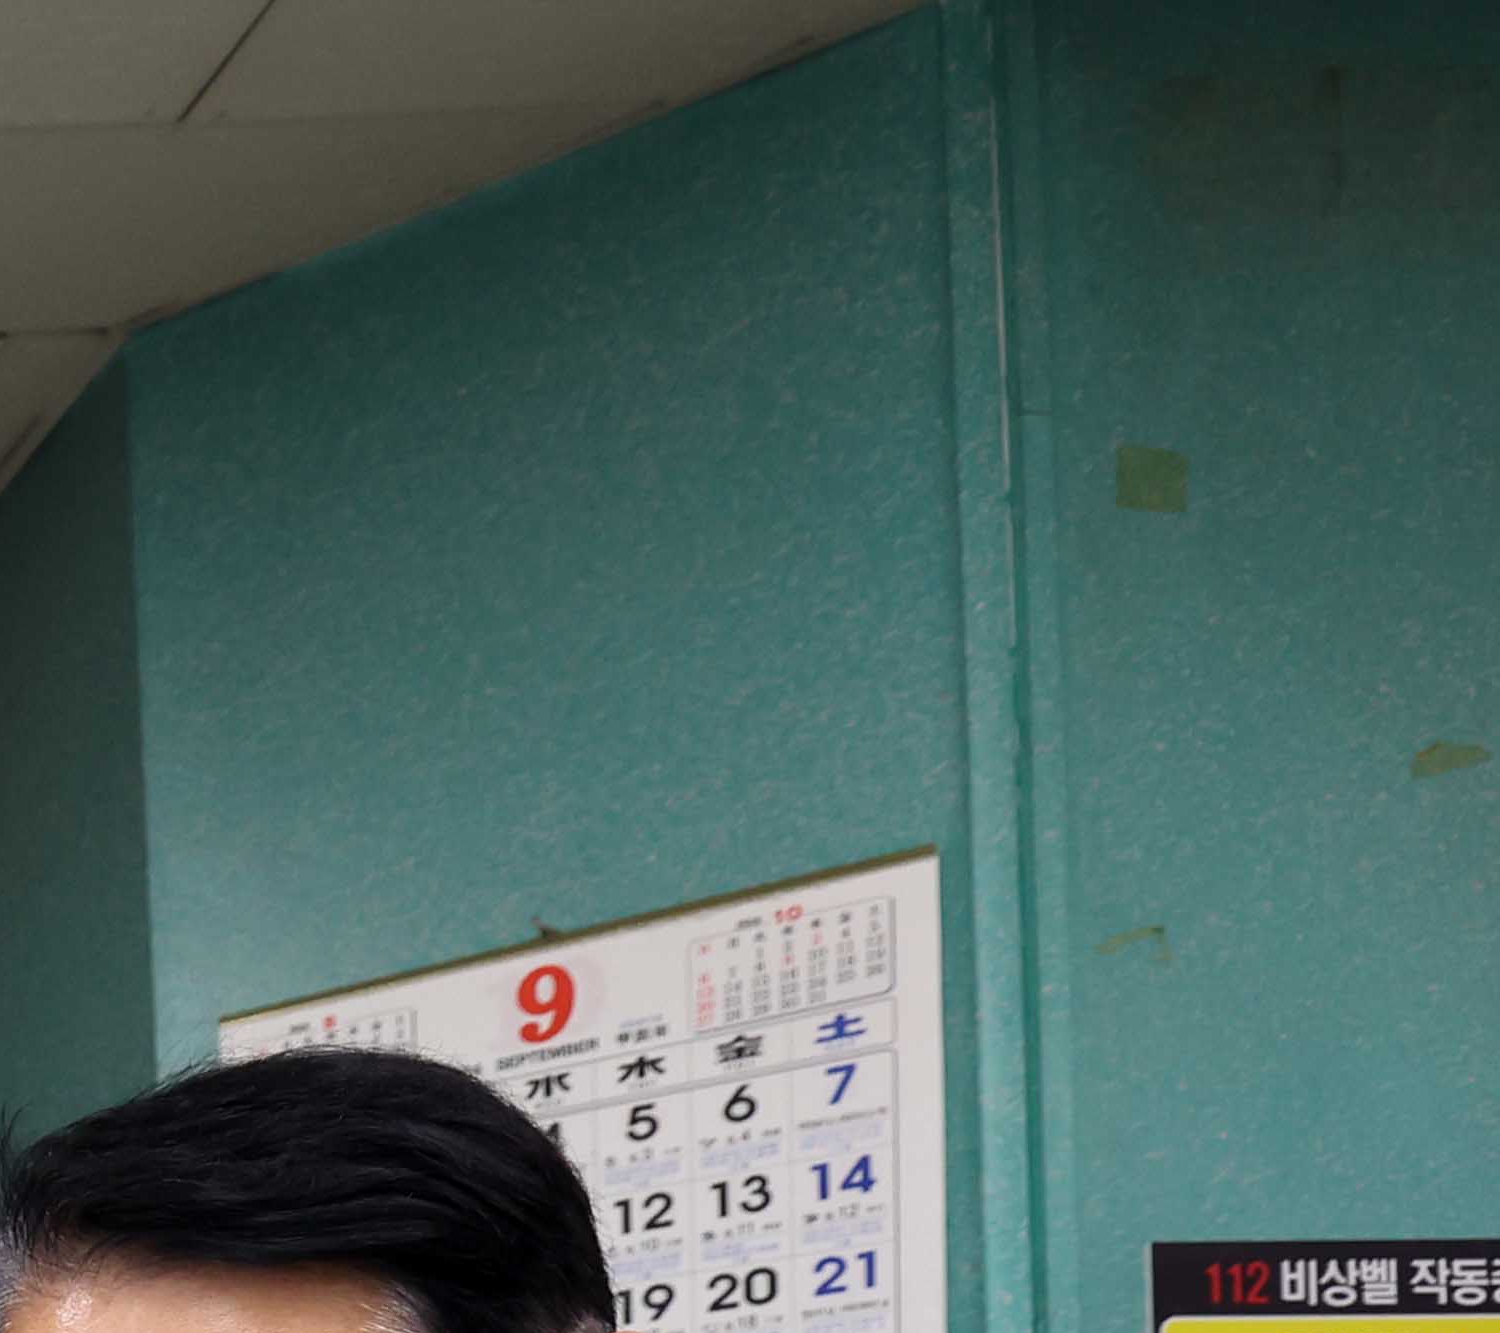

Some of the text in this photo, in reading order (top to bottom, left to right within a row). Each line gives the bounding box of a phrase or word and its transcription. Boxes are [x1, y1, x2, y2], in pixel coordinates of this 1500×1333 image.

[517, 963, 576, 1044] 9
[525, 1072, 571, 1100] 水
[616, 1054, 667, 1083] 木
[814, 1012, 868, 1044] 土
[625, 1103, 659, 1142] 5
[723, 1083, 757, 1123] 6
[824, 1062, 857, 1105] 7
[613, 1153, 877, 1235] 12 13 14
[615, 1250, 877, 1326] 19 20 21
[1205, 1260, 1271, 1305] 112
[1279, 1258, 1399, 1307] 비상벨
